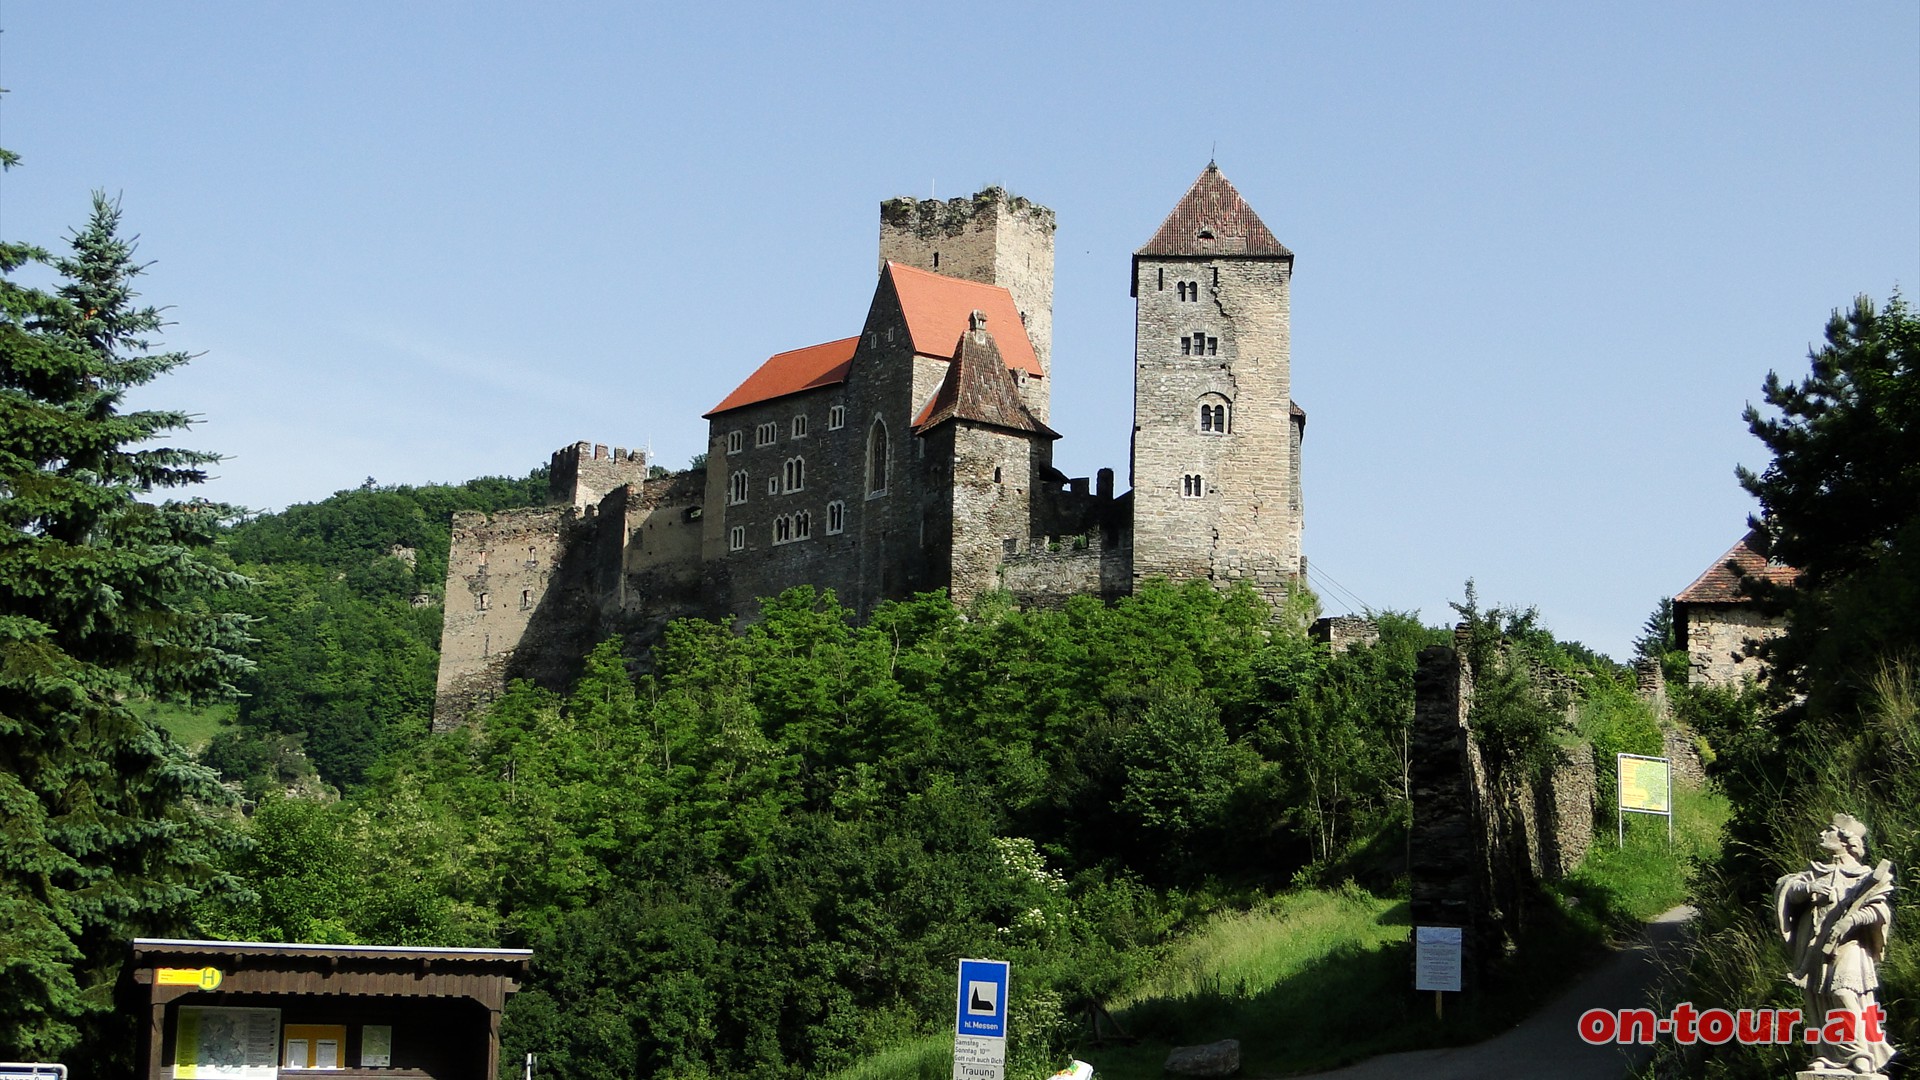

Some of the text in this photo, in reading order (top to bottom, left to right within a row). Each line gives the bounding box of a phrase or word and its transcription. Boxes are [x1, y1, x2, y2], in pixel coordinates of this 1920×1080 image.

[202, 970, 215, 985] H
[973, 1021, 998, 1030] Messen
[956, 1039, 979, 1048] Samstag
[955, 1047, 977, 1055] Sonntag
[961, 1066, 995, 1078] Trauung
